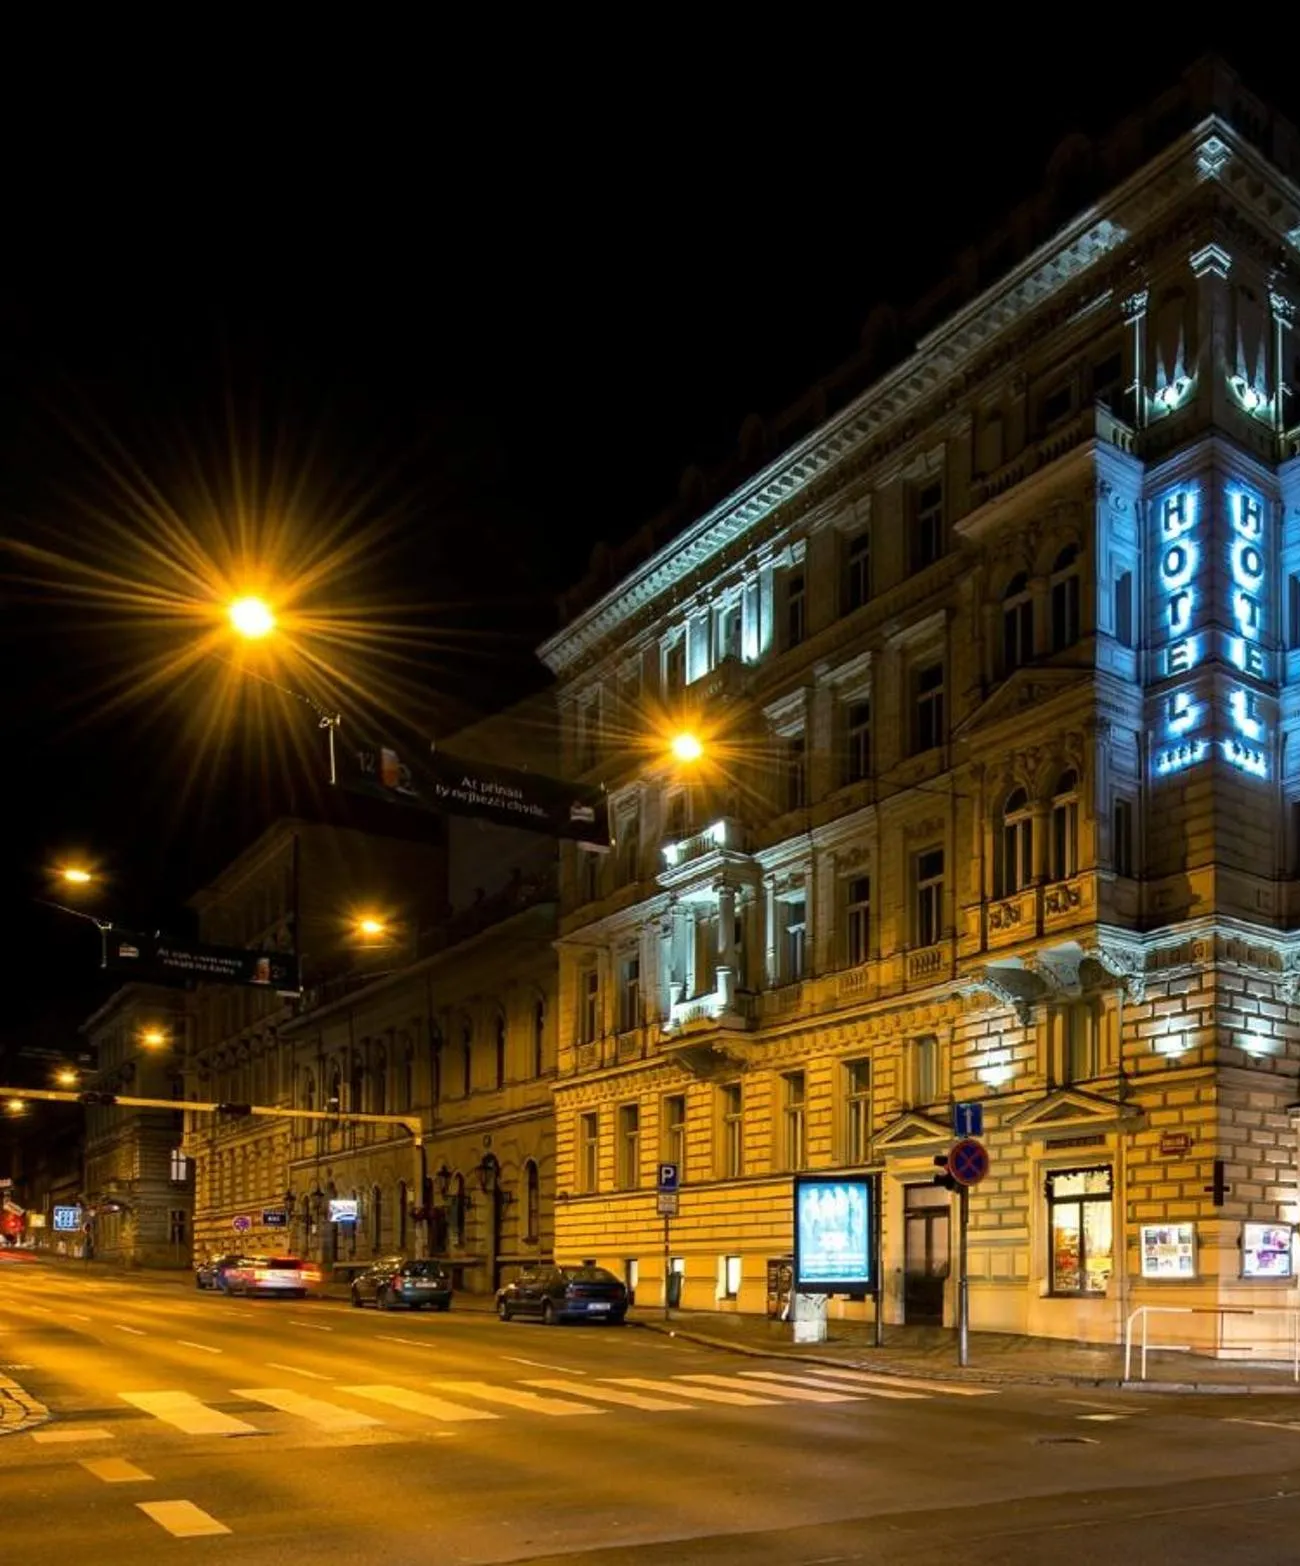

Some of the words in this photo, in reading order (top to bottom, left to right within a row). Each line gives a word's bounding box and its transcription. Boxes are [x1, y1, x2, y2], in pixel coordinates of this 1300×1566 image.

[1162, 491, 1190, 724] HOTEL
[1240, 492, 1265, 728] HOTEL
[661, 1166, 674, 1185] P
